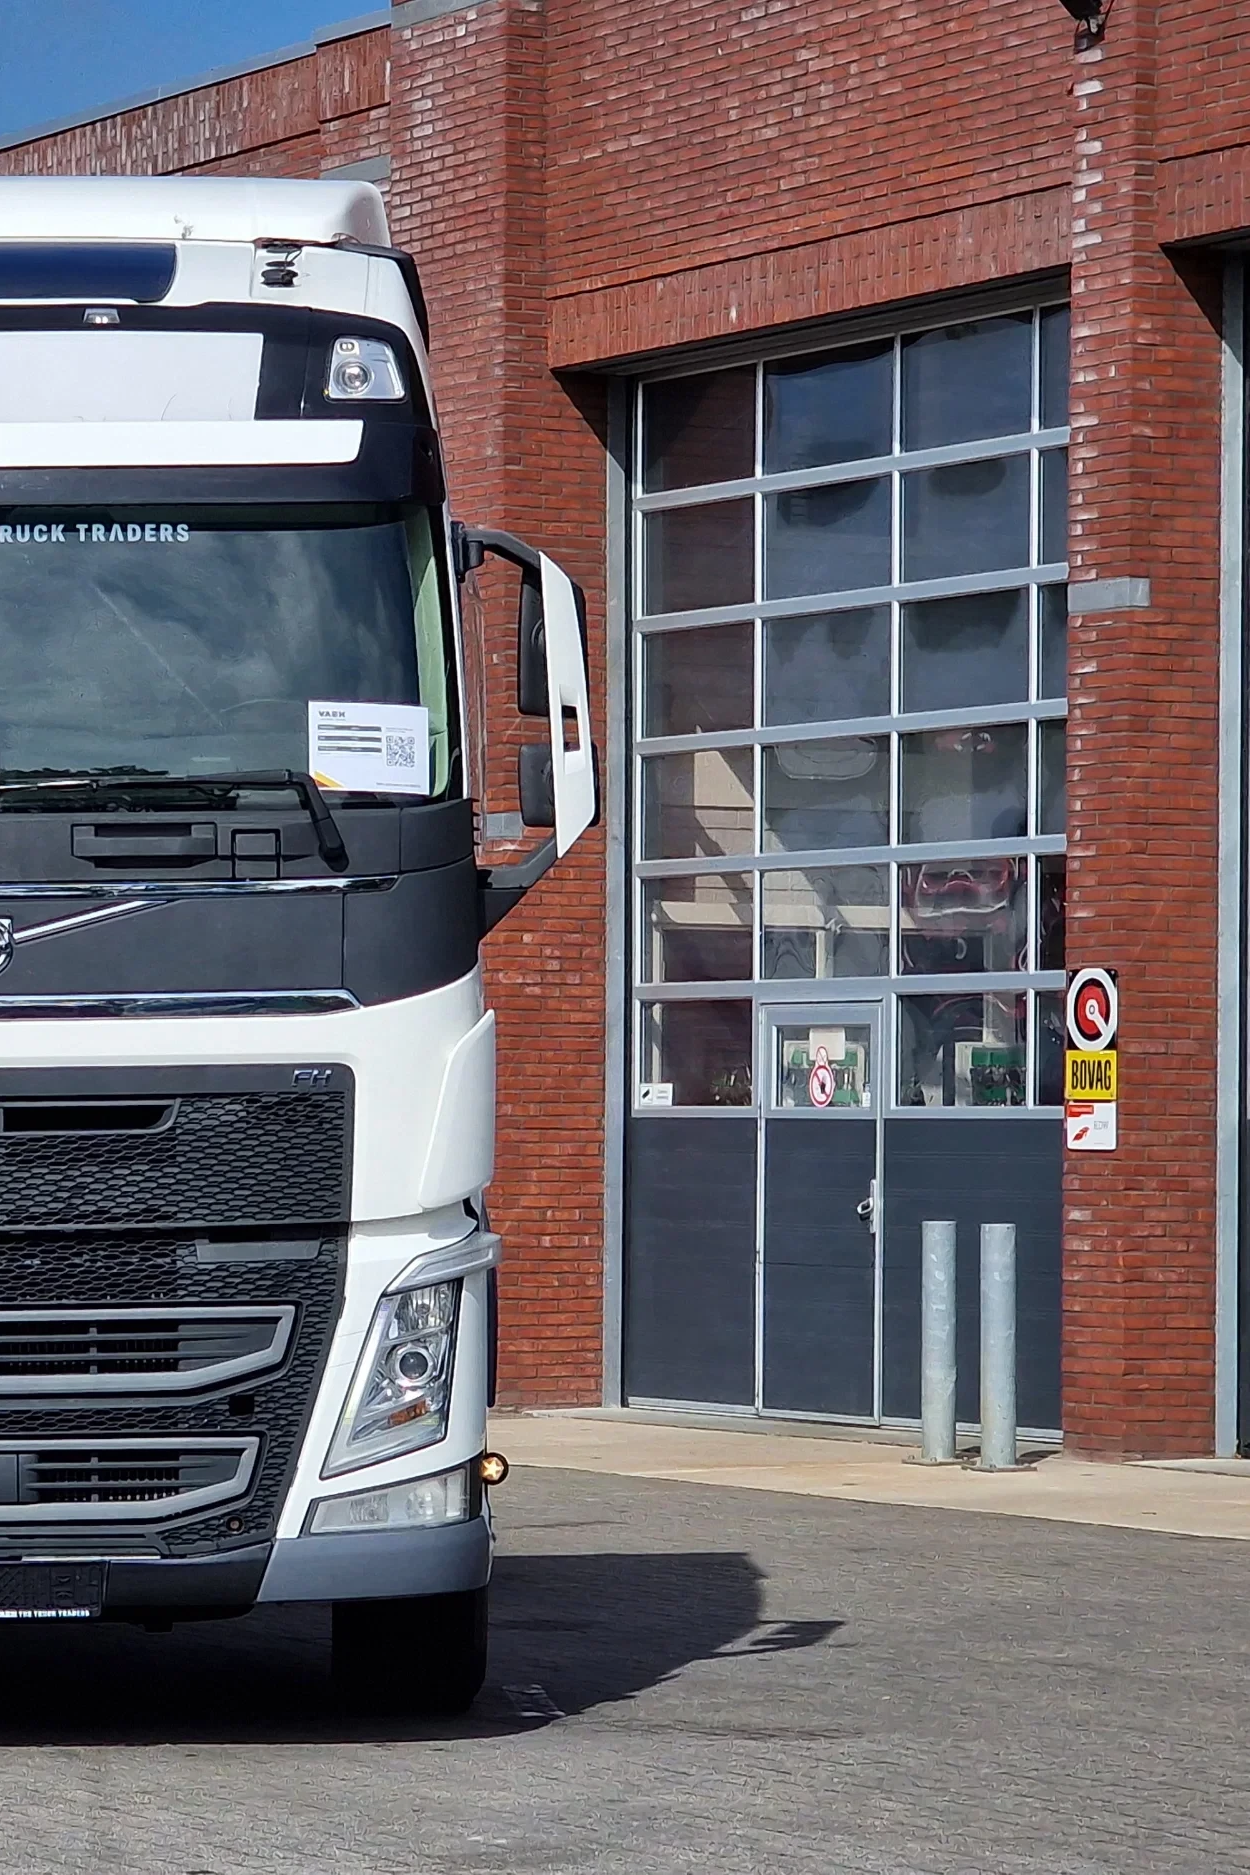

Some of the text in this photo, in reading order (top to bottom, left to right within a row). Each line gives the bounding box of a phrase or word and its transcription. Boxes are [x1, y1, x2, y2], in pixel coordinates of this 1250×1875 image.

[75, 523, 190, 542] TRADERS
[291, 1069, 332, 1087] FH
[1071, 1059, 1112, 1091] BOVAG
